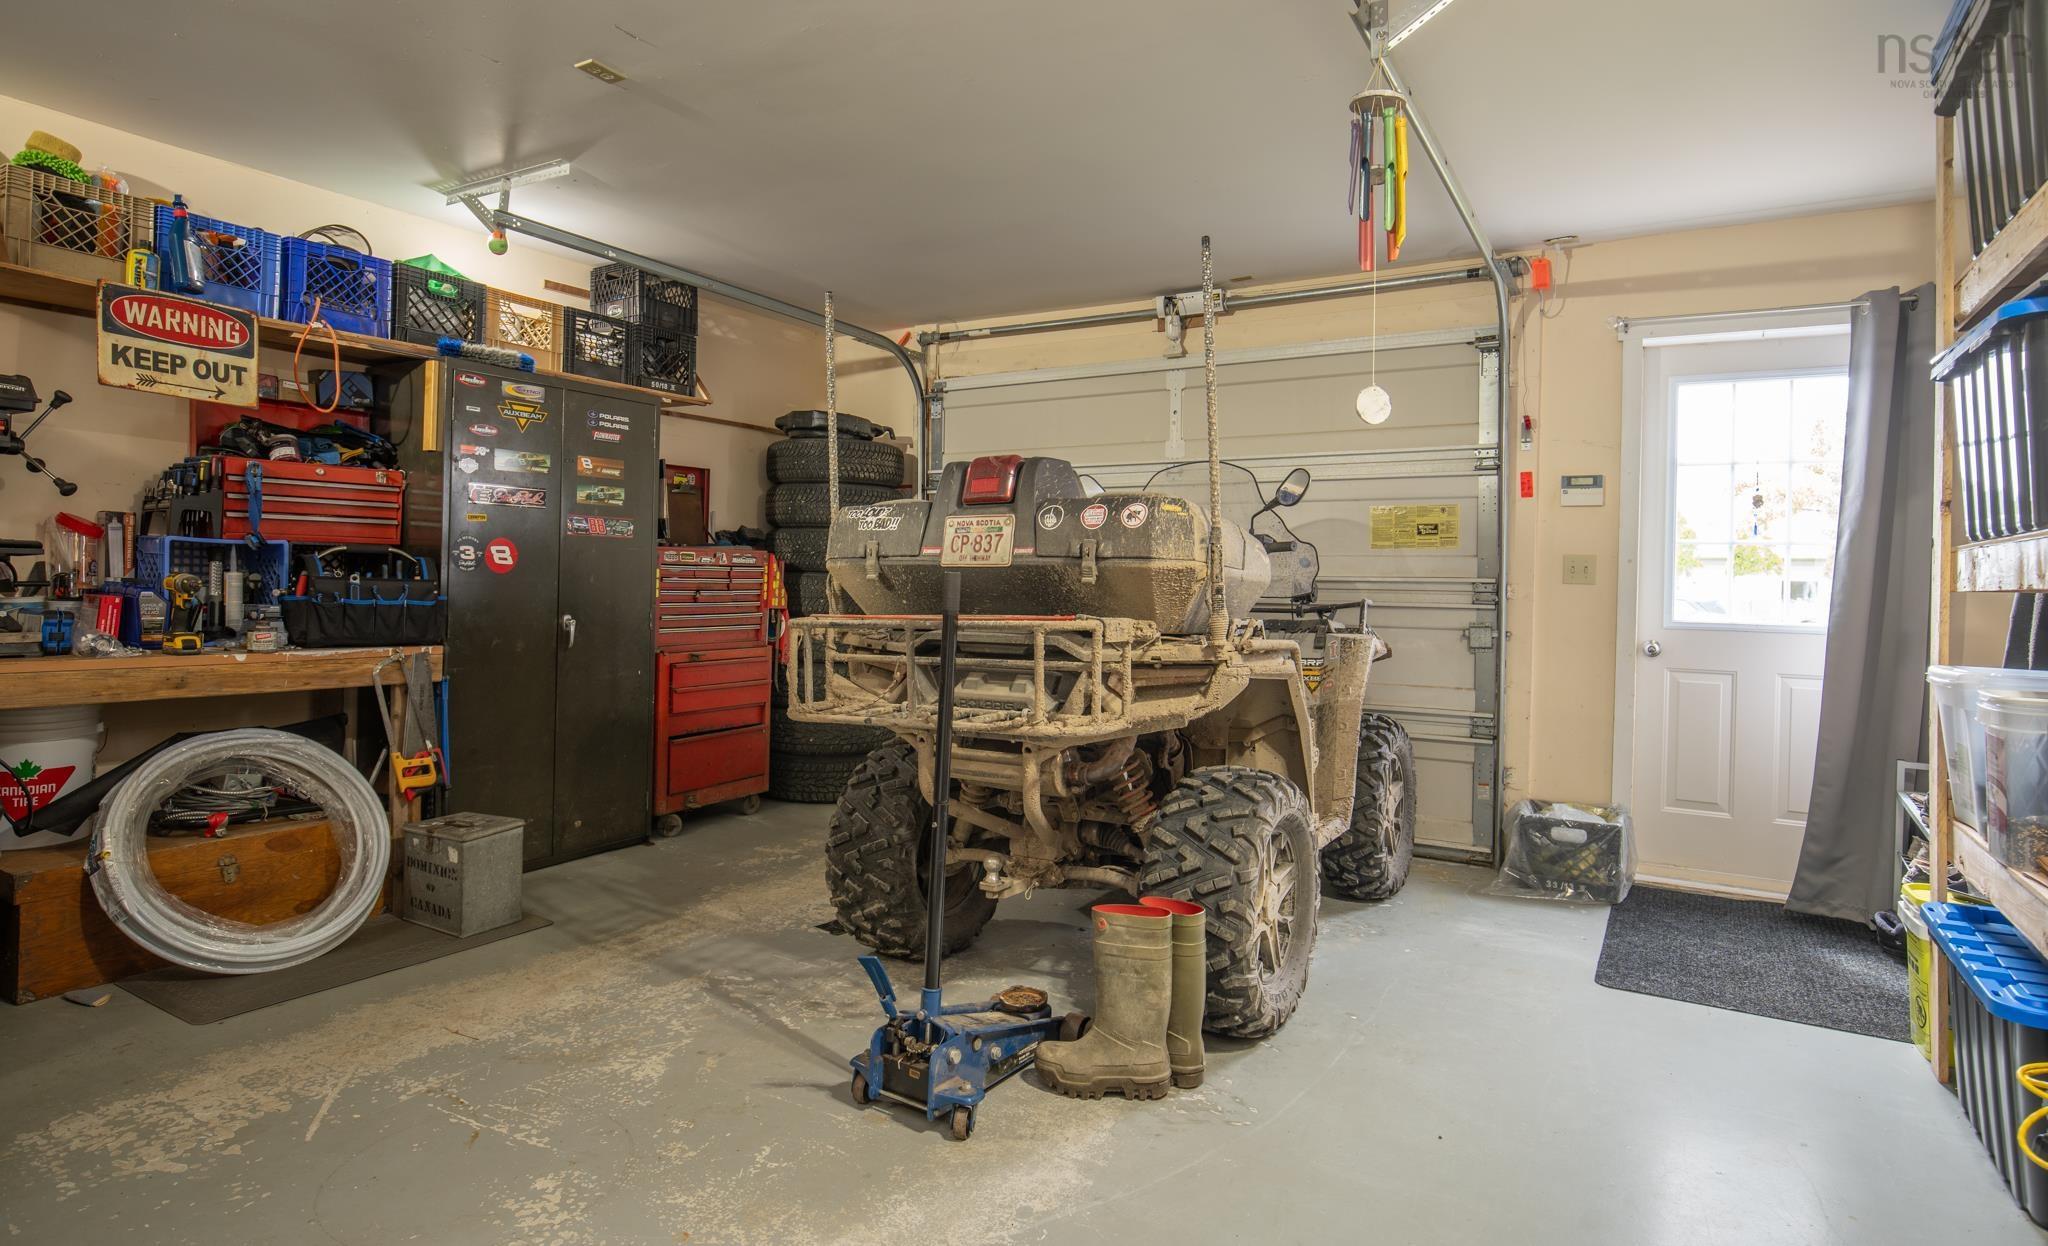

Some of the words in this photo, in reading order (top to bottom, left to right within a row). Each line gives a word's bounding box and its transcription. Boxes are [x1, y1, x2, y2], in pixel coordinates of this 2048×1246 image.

[123, 299, 241, 344] WARNING
[111, 343, 187, 375] KEEP
[192, 358, 248, 386] OUT
[503, 409, 542, 419] AUXBEAM
[599, 413, 630, 422] POLARIS
[599, 421, 629, 430] POLARIS
[581, 457, 593, 468] 8
[588, 517, 607, 534] 88
[858, 519, 874, 531] TOO
[976, 519, 1001, 527] SCOTIA
[460, 545, 475, 560] 3
[490, 545, 514, 565] 8
[409, 896, 452, 920] CANADA
